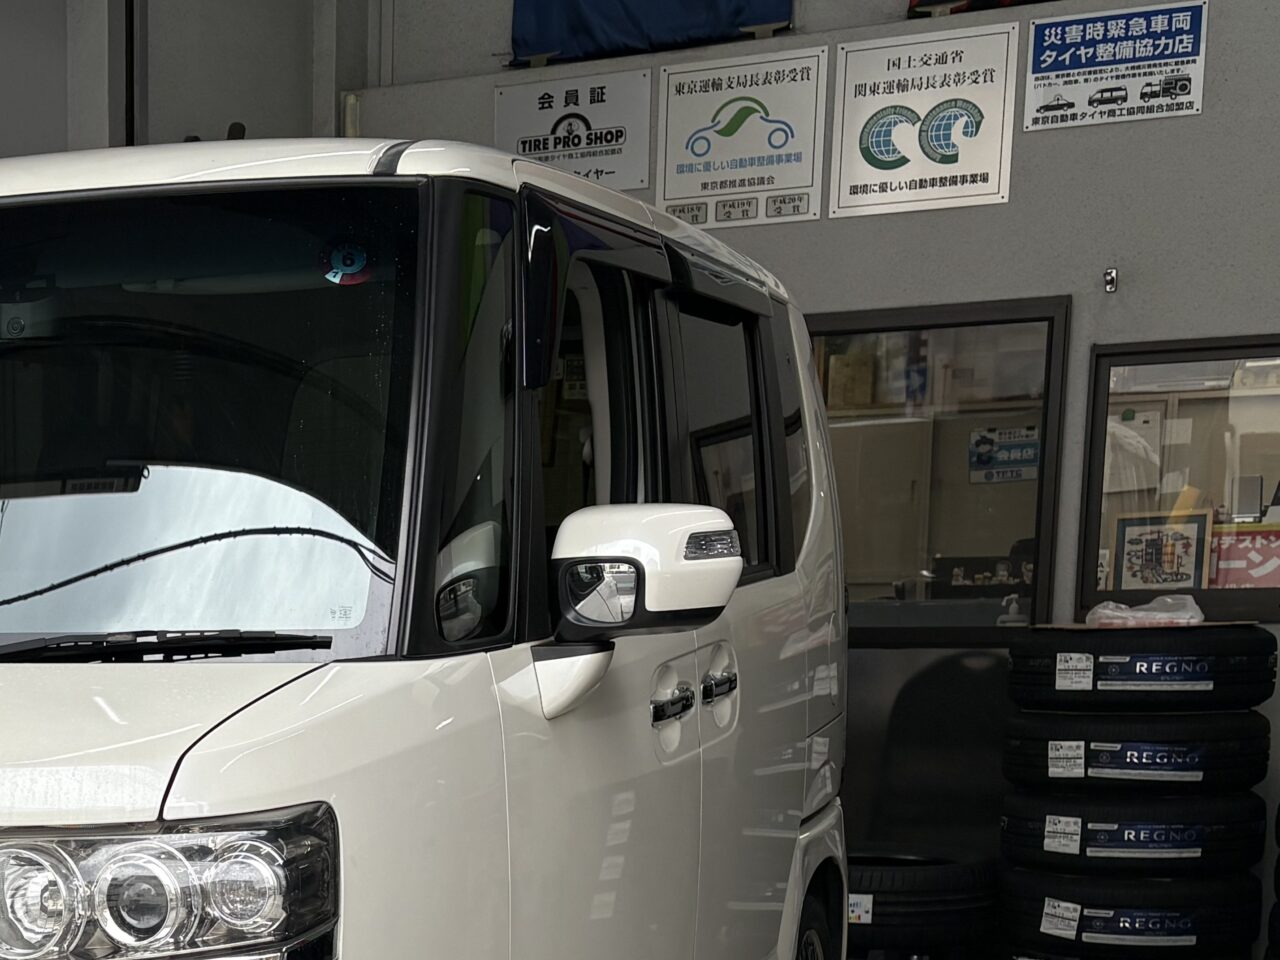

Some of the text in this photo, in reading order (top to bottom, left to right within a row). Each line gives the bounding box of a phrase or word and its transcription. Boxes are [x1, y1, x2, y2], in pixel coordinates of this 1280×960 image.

[1043, 12, 1192, 46] 災害時緊急車両
[887, 50, 964, 71] 国土交通省
[1040, 35, 1194, 68] タイヤ整備協力店
[674, 66, 812, 96] 東京運輸支局長表彰受賞
[854, 68, 996, 98] 関東運輸局長表彰受賞
[538, 85, 607, 110] 会員証
[1032, 101, 1195, 126] 東京自動車タイヤ商工協同組合加盟店
[520, 129, 624, 153] TIRE PRO SHOP
[676, 151, 803, 174] 環境に優しい自動車整備事業場
[700, 175, 776, 192] 東京都推進協議会
[849, 172, 990, 195] 環境に優しい自動車整備事業場
[1135, 661, 1209, 674] REGNO
[1125, 750, 1200, 764] REGNO
[1123, 828, 1197, 842] REGNO
[1119, 916, 1192, 930] REGNO
